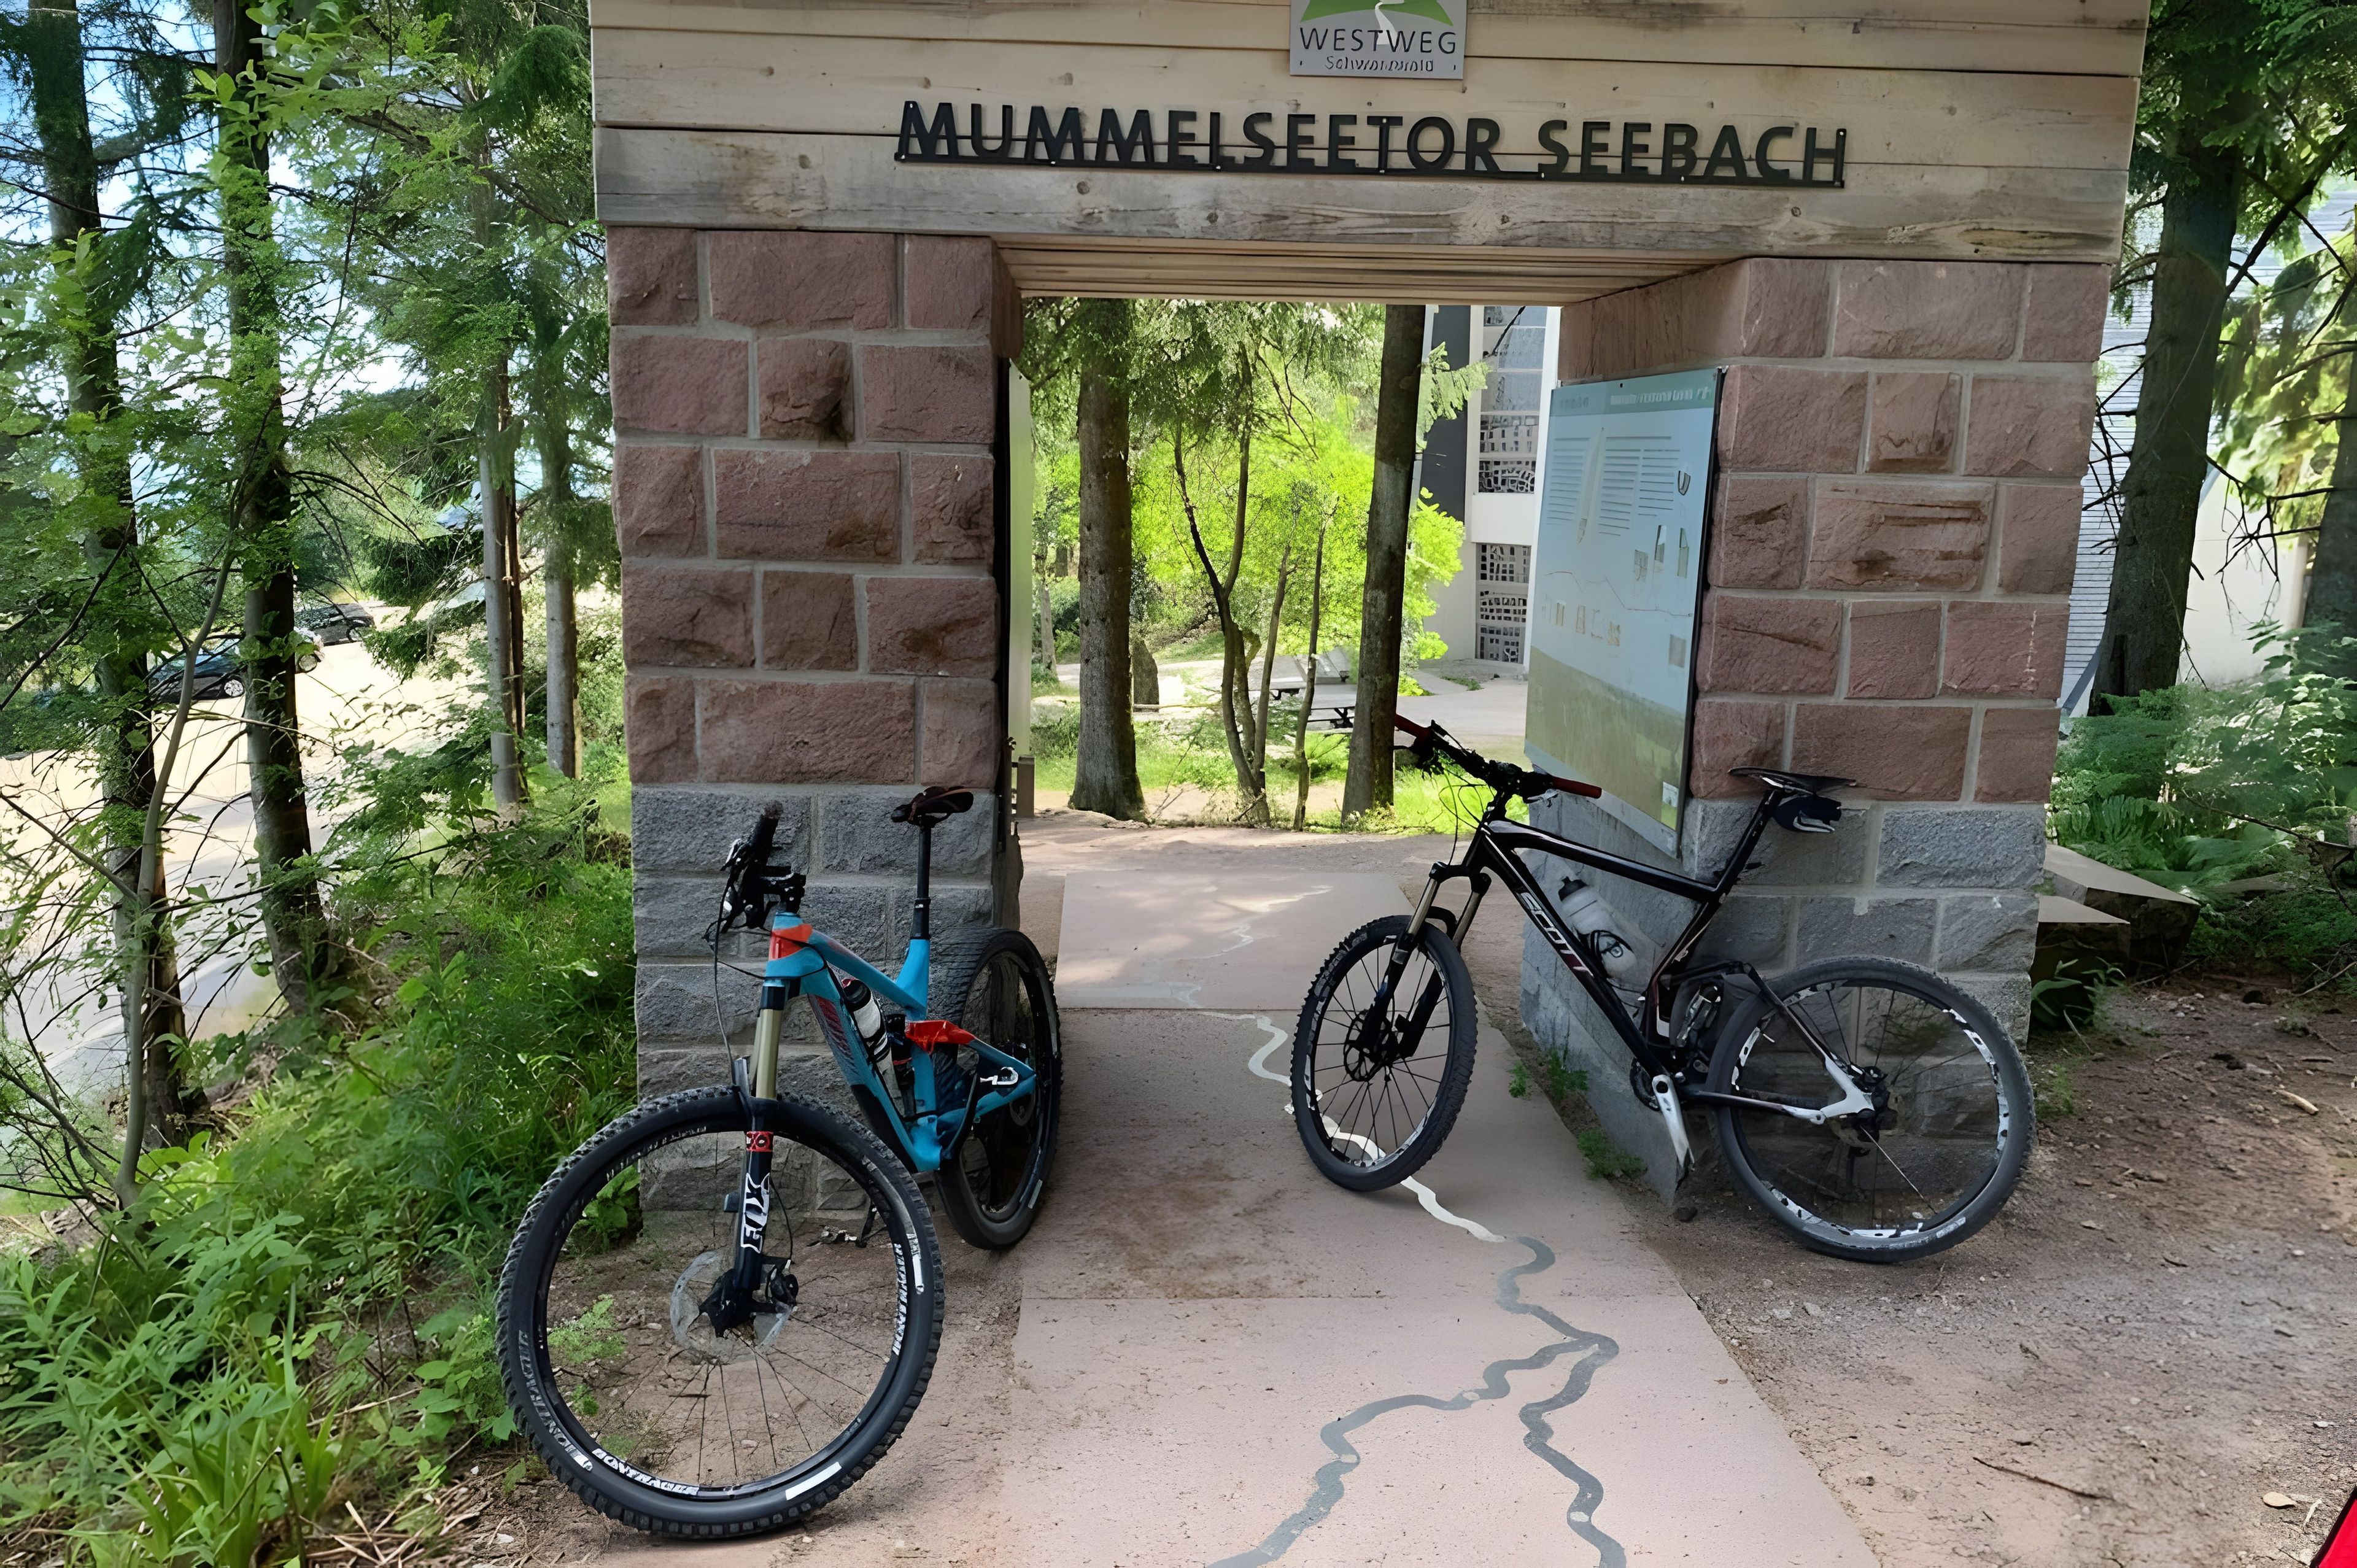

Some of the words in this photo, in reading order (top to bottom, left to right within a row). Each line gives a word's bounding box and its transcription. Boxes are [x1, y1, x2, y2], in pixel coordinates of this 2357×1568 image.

[1299, 27, 1456, 54] WESTWEG
[894, 100, 1501, 176] MUMMELSEETOR
[1536, 118, 1848, 187] SEEBACH
[1516, 892, 1594, 978] SCOTT
